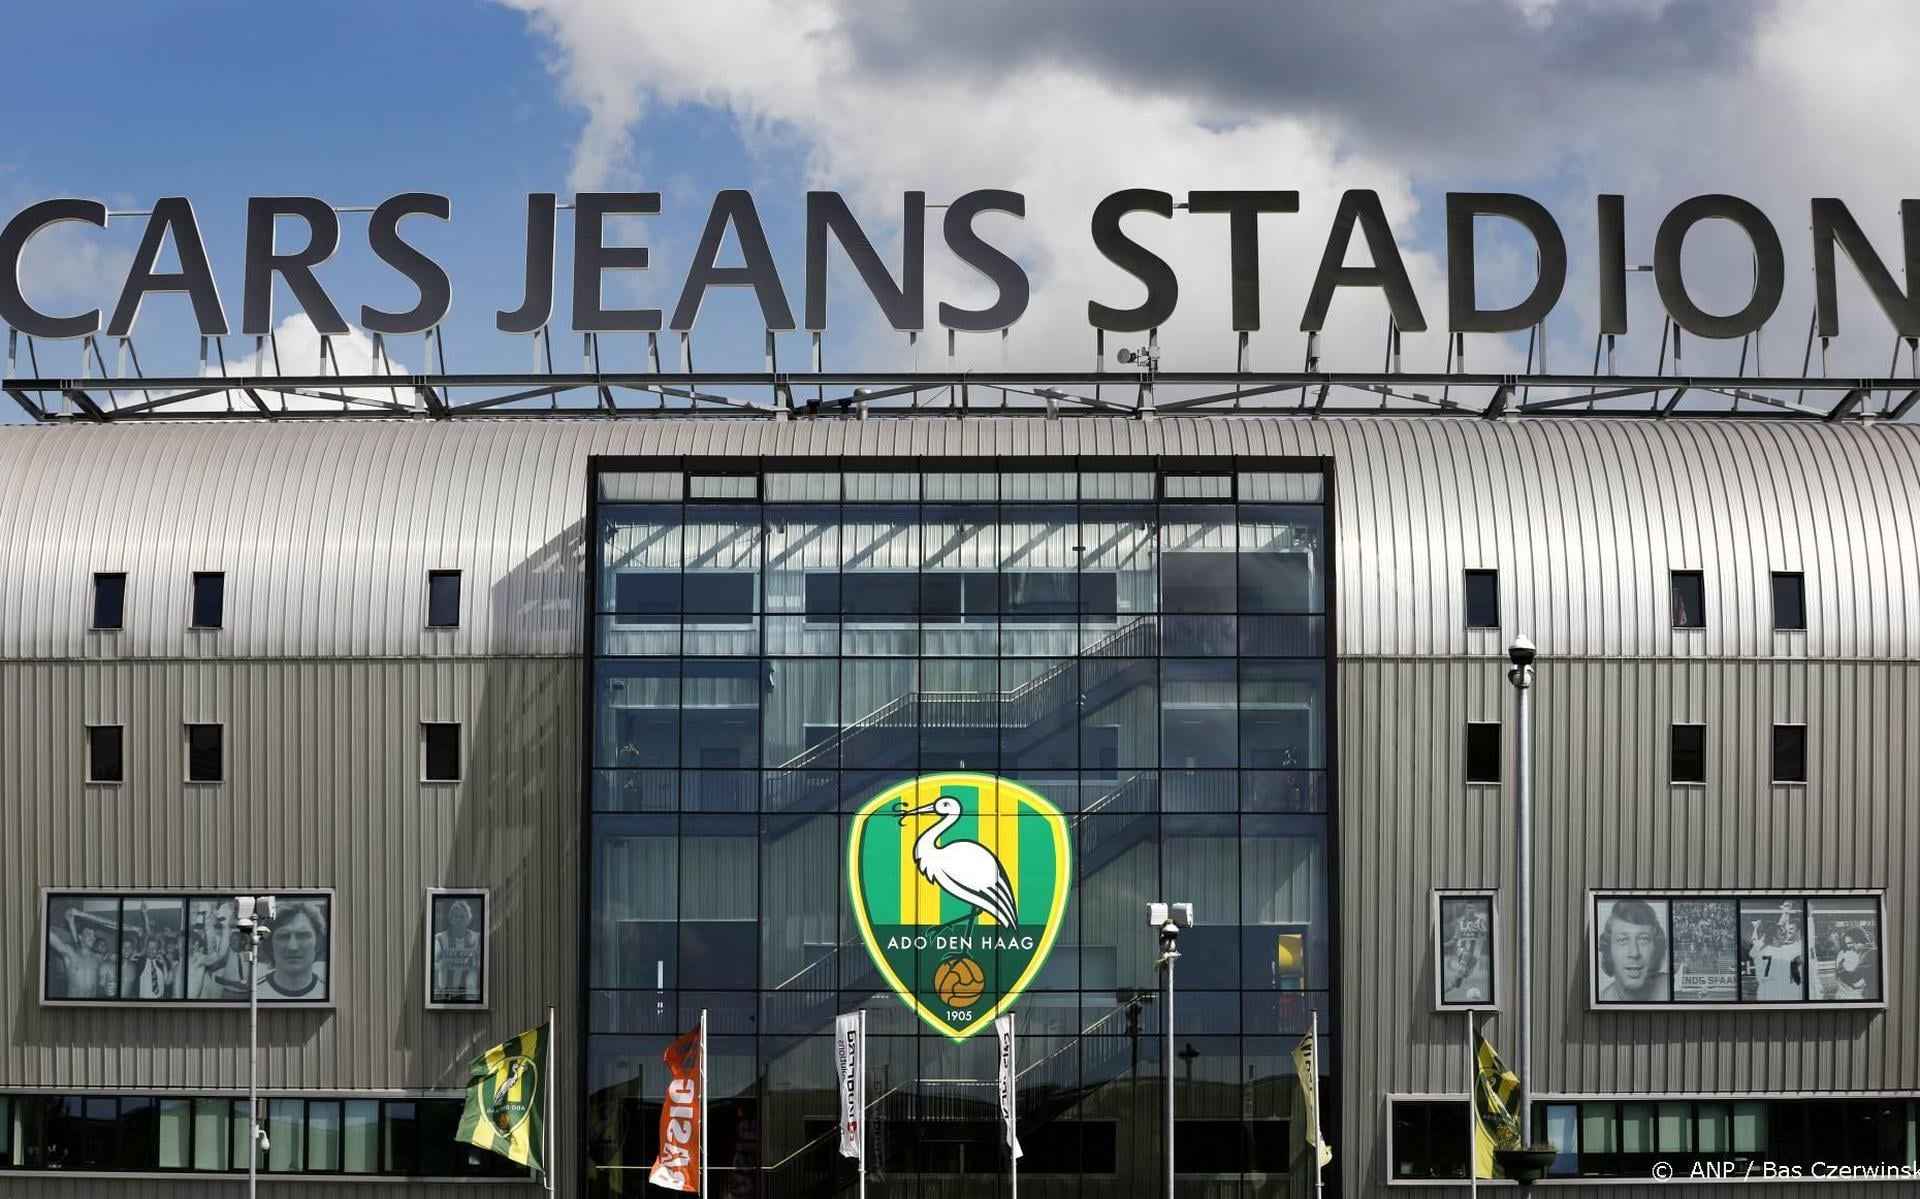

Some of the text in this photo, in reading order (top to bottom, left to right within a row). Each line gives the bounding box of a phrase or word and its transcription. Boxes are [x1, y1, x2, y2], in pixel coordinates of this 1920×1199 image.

[0, 188, 1920, 339] CARS JEANS STADION
[887, 936, 1034, 950] ADO DEN HAAG
[1762, 955, 1772, 977] 7
[946, 1010, 973, 1022] 1905
